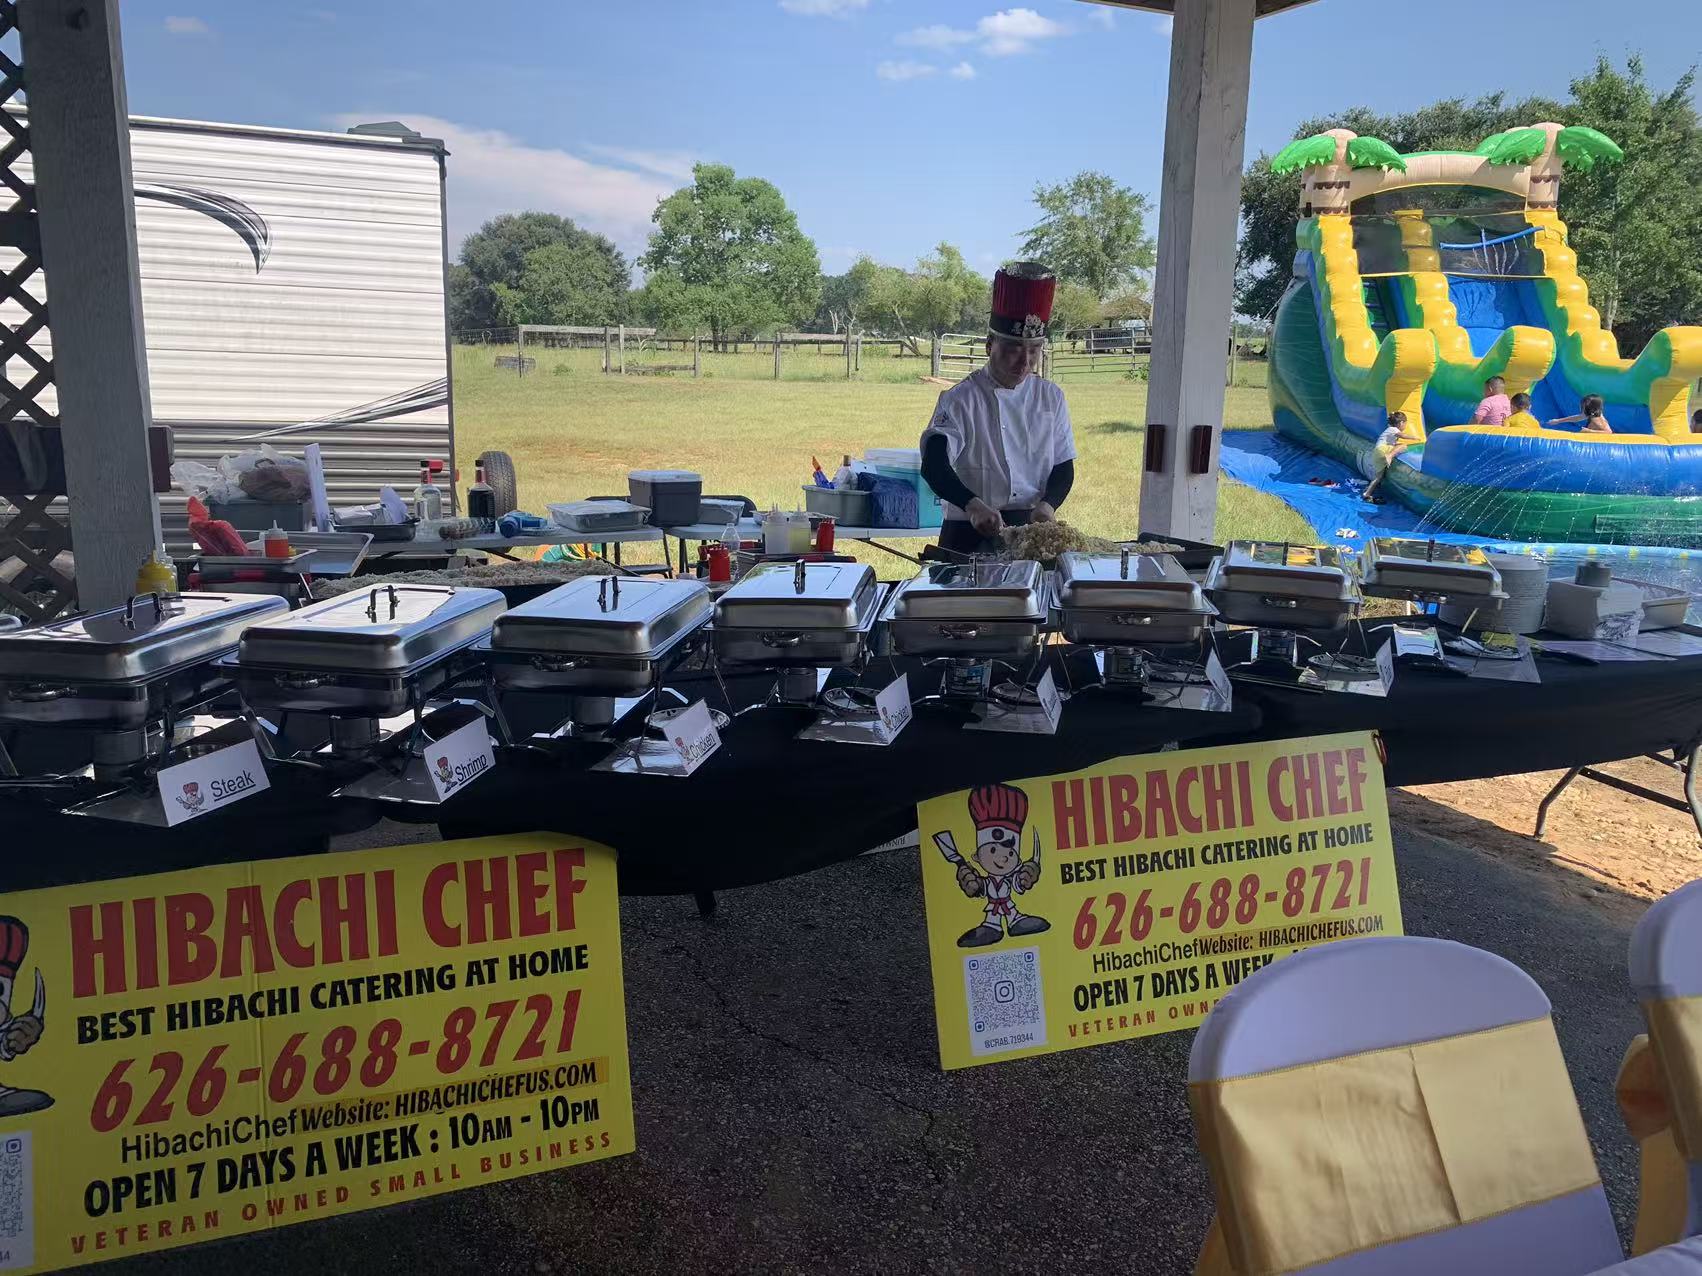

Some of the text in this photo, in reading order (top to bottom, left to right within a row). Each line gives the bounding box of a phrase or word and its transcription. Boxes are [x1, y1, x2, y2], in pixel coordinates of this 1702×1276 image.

[210, 770, 255, 799] Steak
[455, 754, 488, 783] Shrimp
[689, 733, 716, 759] Chicken
[1052, 747, 1368, 850] HIBACHI CHEF
[1060, 822, 1374, 885] BEST HIBACHI CATERING AT HOME
[69, 847, 588, 998] HIBACHI CHEF
[1073, 857, 1372, 951] 626-688-8721
[1092, 914, 1384, 974] HibachiChef Website: HIBACHICHEFUS.COM
[77, 944, 589, 1045] BEST HIBACHI CATERING AT HOME
[1067, 998, 1219, 1039] VETERAN OWN
[1072, 978, 1129, 1013] OPEN
[1133, 974, 1145, 1000] 7
[1151, 965, 1200, 998] DAYS
[1205, 962, 1219, 989] A
[90, 989, 582, 1133] 626-688-8721
[84, 1166, 178, 1218] OPEN
[186, 1162, 206, 1199] 7
[217, 1146, 296, 1194] DAYS
[305, 1140, 326, 1177] A
[335, 1123, 421, 1170] WEEK
[449, 1114, 513, 1152] 10AM
[541, 1095, 600, 1131] 10PM
[121, 1061, 598, 1164] HibachiChef Website: HIBACHICHEFUS.COM
[70, 1130, 612, 1255] VETERAN OWNED SMALL BUSINESS
